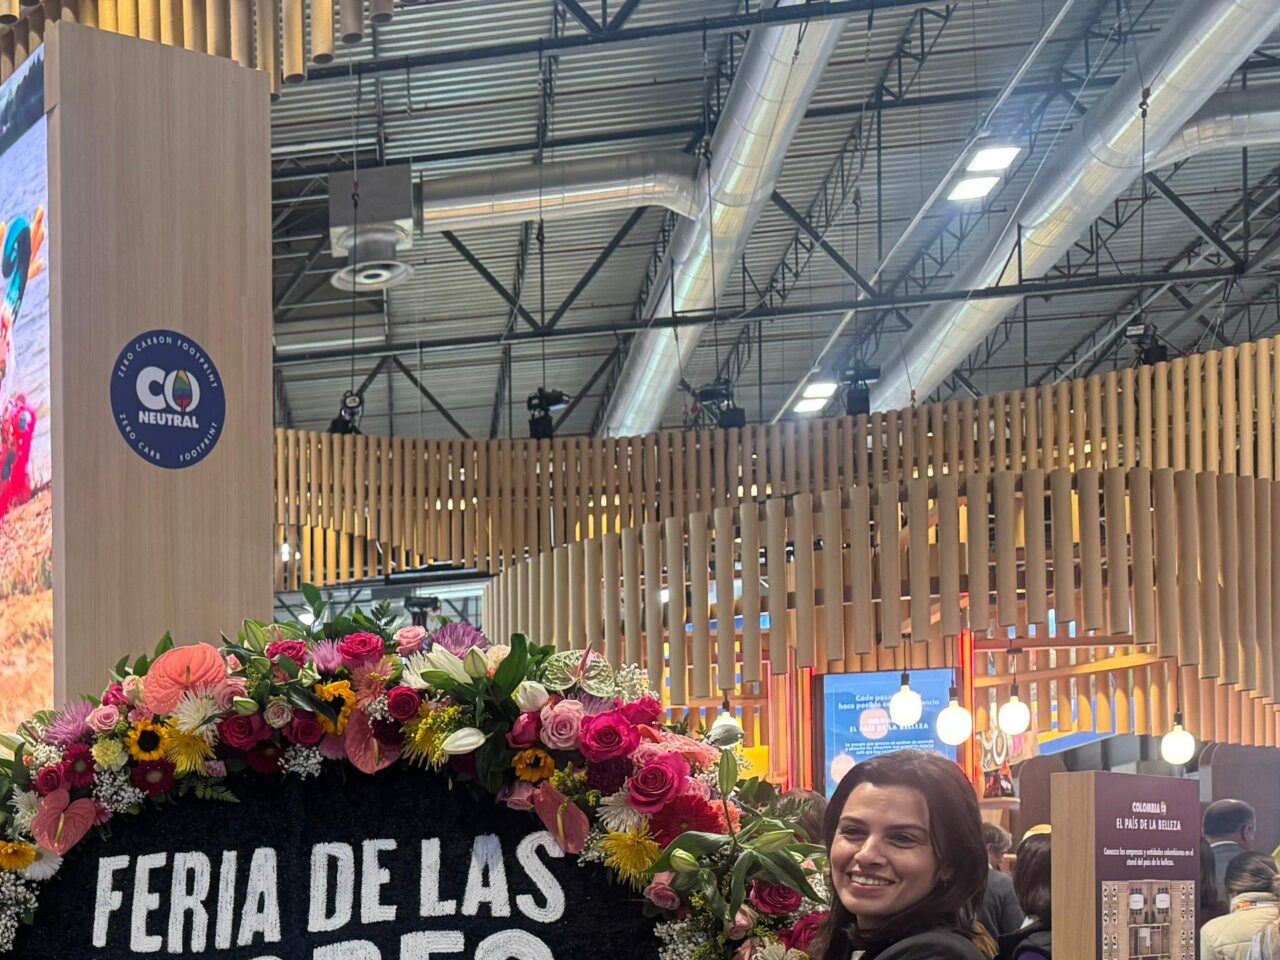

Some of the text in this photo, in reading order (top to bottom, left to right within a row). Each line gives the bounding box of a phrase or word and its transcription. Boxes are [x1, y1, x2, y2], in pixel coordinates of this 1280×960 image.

[118, 336, 217, 388] ZERO CARBON FOOTPRINT
[139, 411, 199, 428] NEUTRAL
[120, 413, 136, 440] ZERO
[179, 421, 218, 462] FOOTPRINT
[1116, 815, 1181, 831] EL PAÍS DE LA BELLEZA
[1132, 801, 1160, 813] COLOMBIA
[91, 830, 565, 953] FERIA DE LAS
